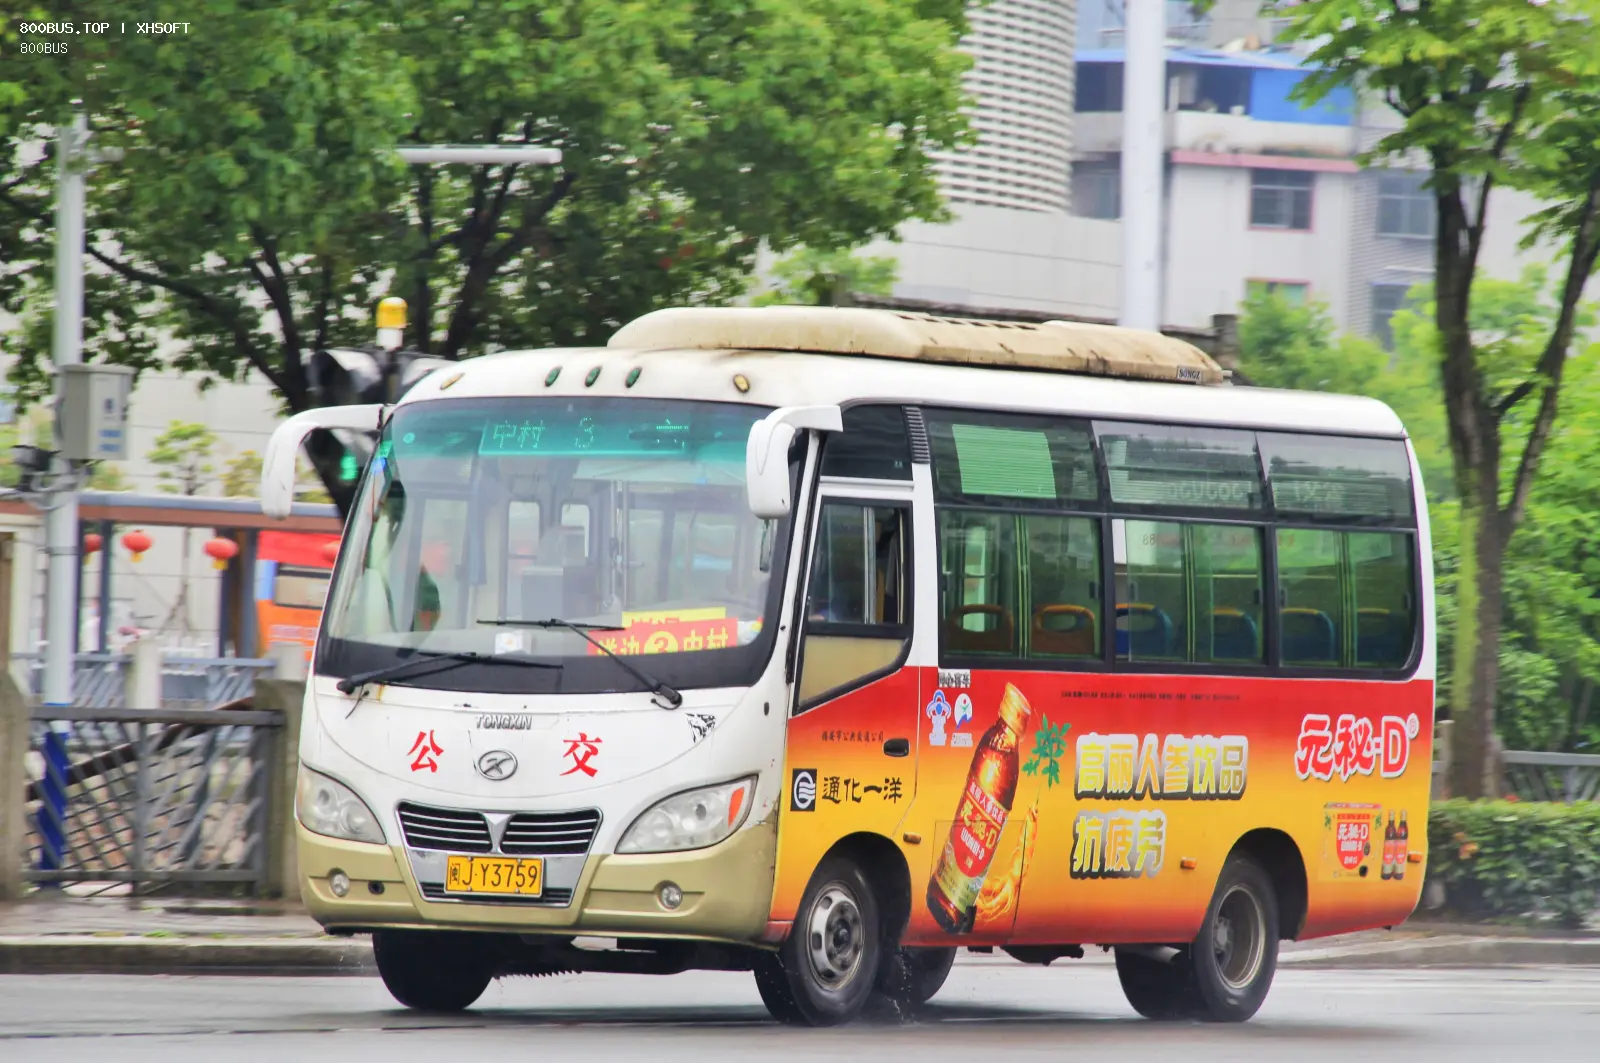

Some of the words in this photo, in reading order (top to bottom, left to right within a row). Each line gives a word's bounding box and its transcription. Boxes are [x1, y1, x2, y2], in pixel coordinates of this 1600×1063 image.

[476, 713, 533, 730] TONGXIN
[406, 729, 445, 773] 公
[559, 732, 603, 778] 交
[1075, 732, 1248, 801] 高丽人参饮品
[821, 775, 903, 805] 通化一洋
[1070, 809, 1167, 880] 抗疲劳
